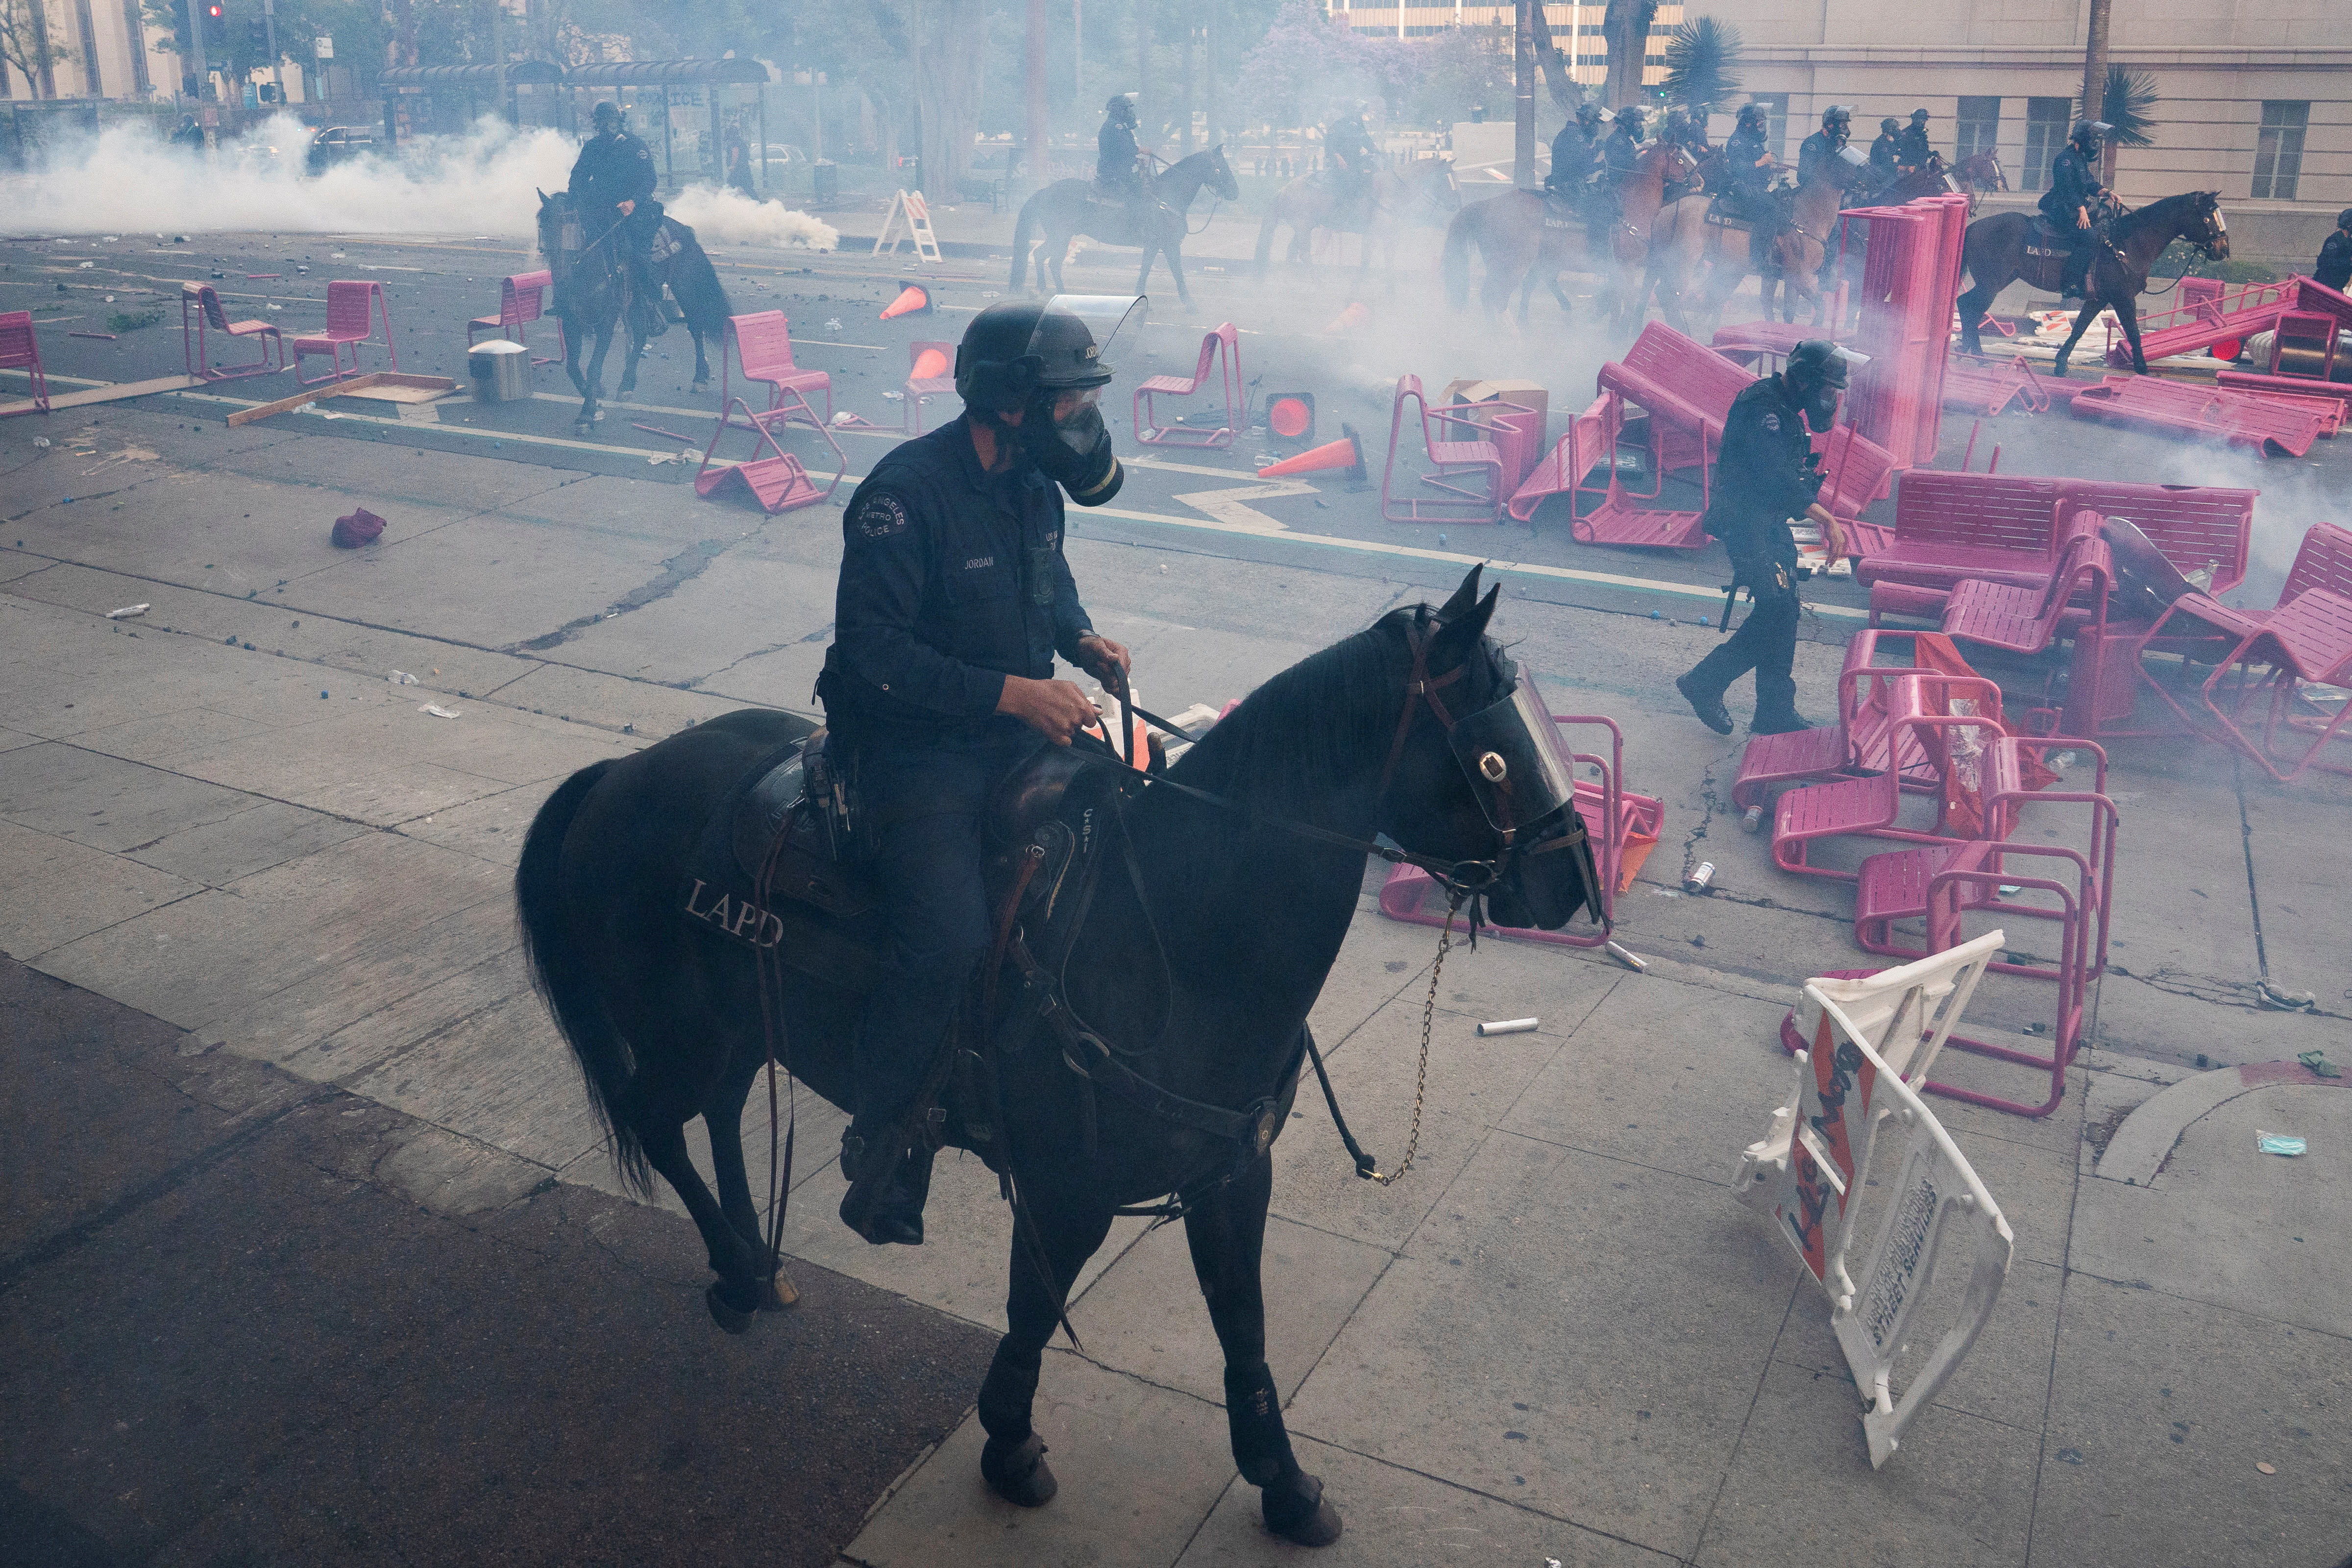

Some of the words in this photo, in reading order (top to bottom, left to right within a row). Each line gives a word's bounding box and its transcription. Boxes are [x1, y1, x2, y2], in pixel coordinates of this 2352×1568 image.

[1709, 214, 1732, 225] LAD
[2027, 245, 2052, 256] LAD
[866, 512, 891, 521] METRO
[873, 497, 905, 525] ANGELES
[861, 522, 890, 537] POLICE
[965, 557, 994, 569] JORDAN
[686, 878, 783, 948] LAPD
[1872, 1273, 1907, 1347] STREET
[1901, 1189, 1937, 1278] SERVICES
